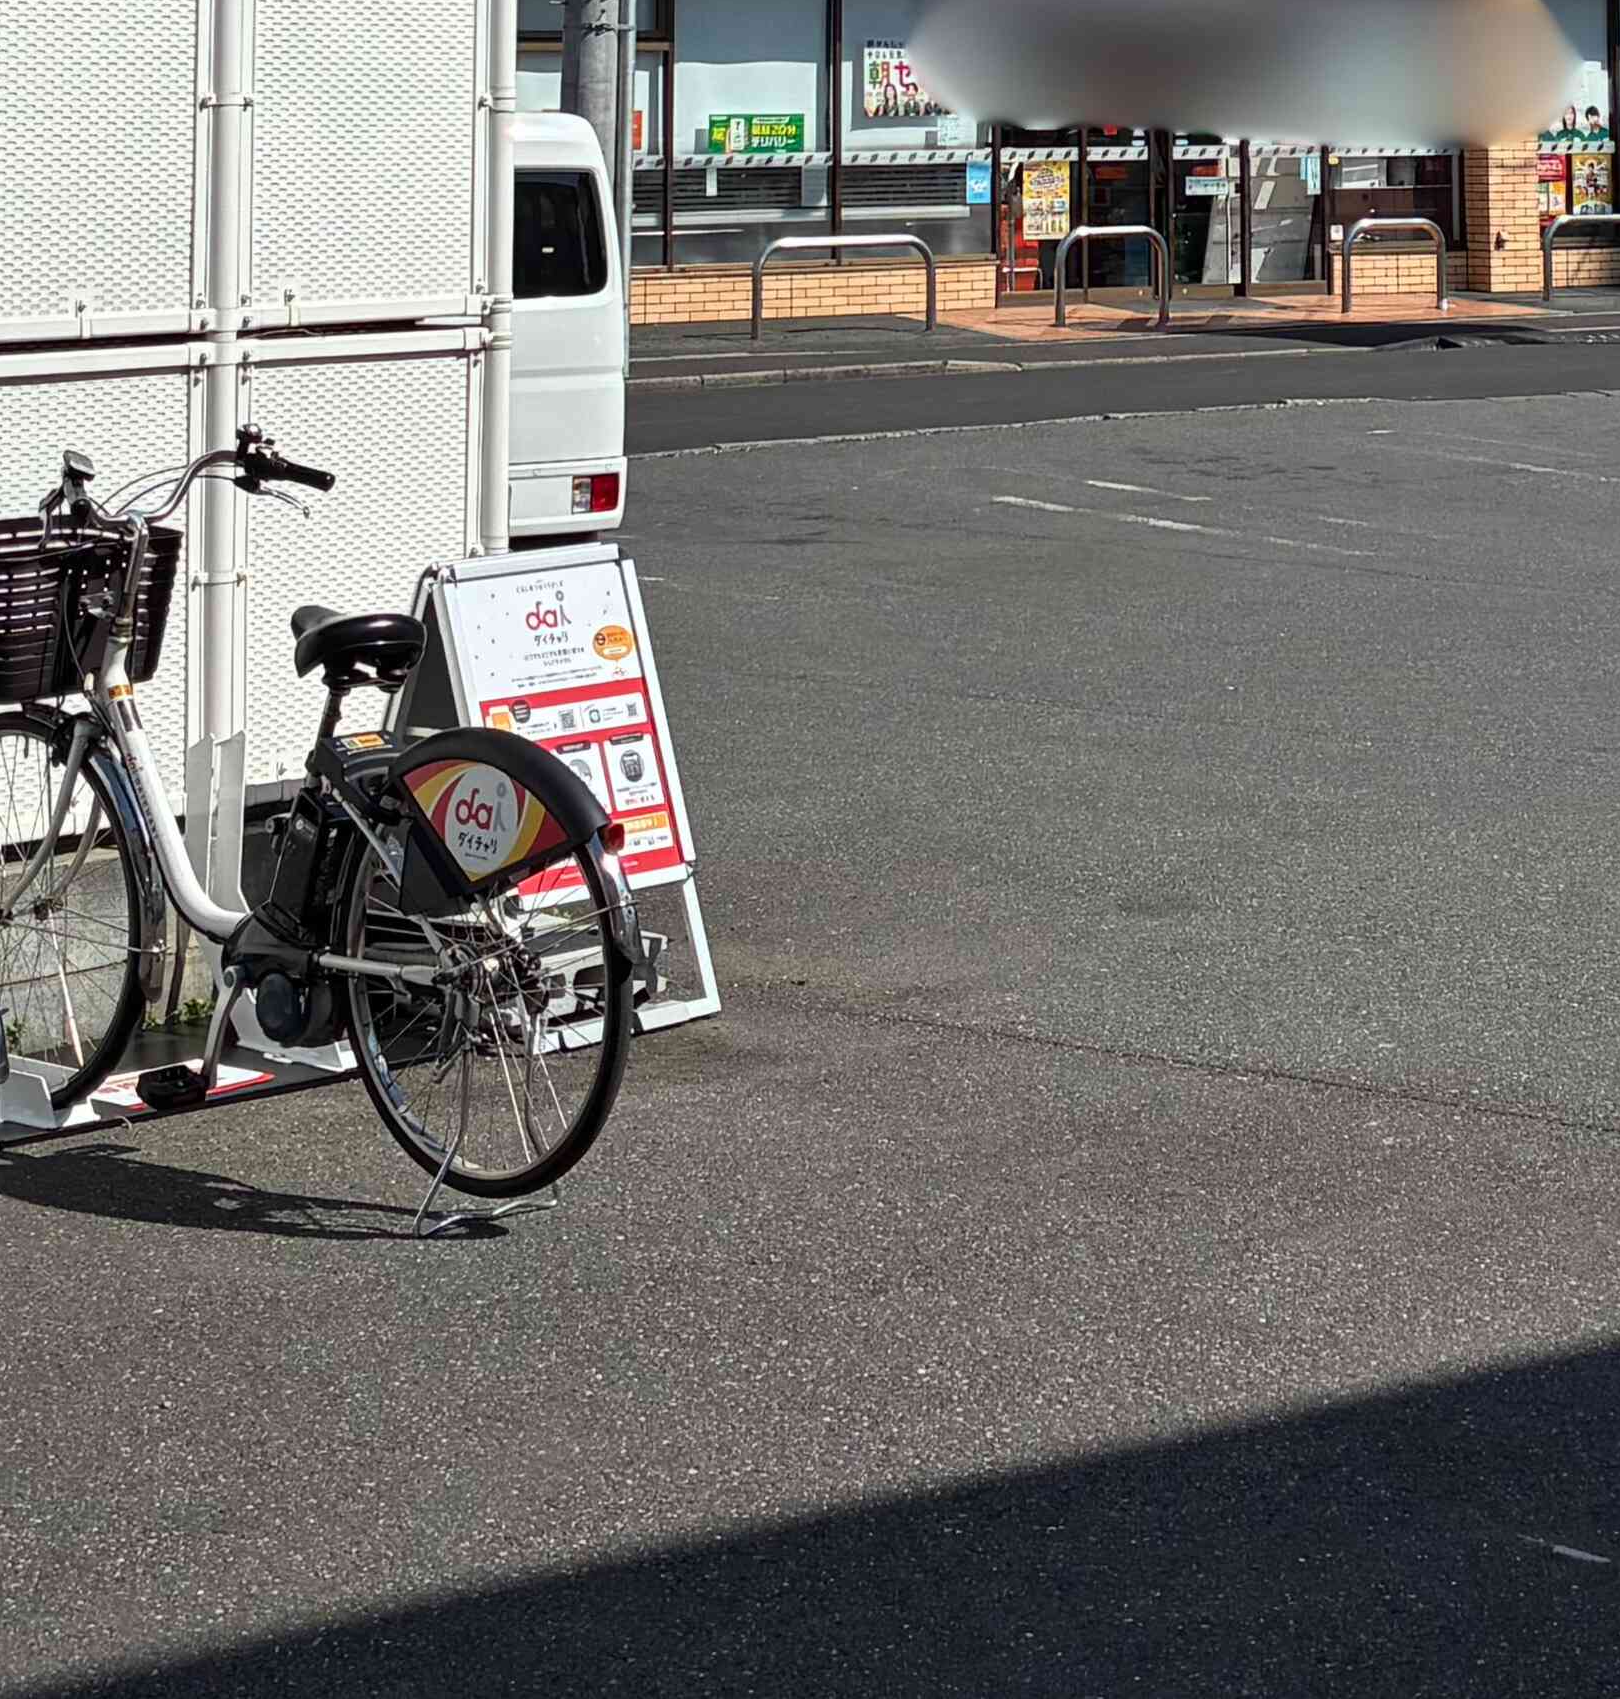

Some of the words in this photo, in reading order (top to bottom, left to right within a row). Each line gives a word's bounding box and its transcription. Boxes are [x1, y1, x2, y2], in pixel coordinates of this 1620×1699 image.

[458, 831, 499, 855] ダイチャリ
